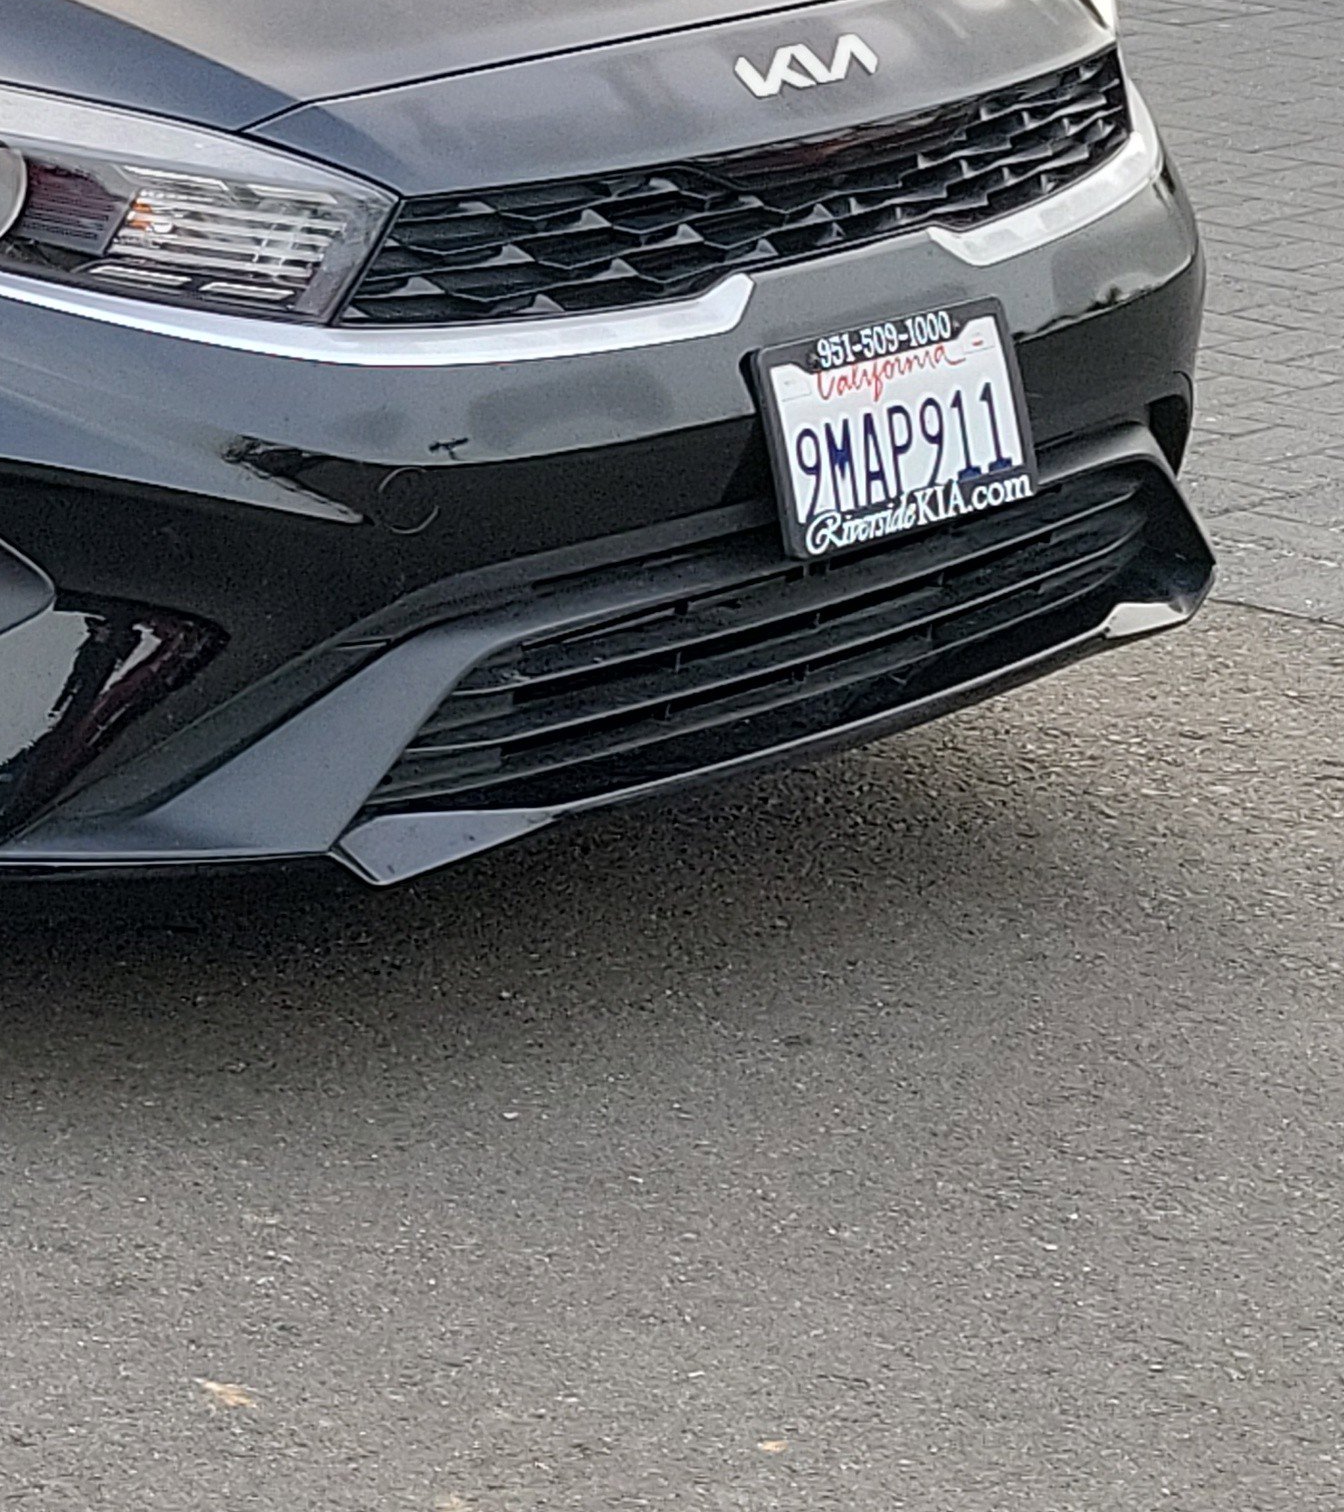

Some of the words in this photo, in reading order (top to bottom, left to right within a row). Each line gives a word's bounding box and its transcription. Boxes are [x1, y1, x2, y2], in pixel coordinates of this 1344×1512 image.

[734, 33, 879, 98] KIA
[816, 311, 952, 369] 951-509-1000
[815, 344, 966, 402] California
[796, 382, 1012, 524] 9MAP911
